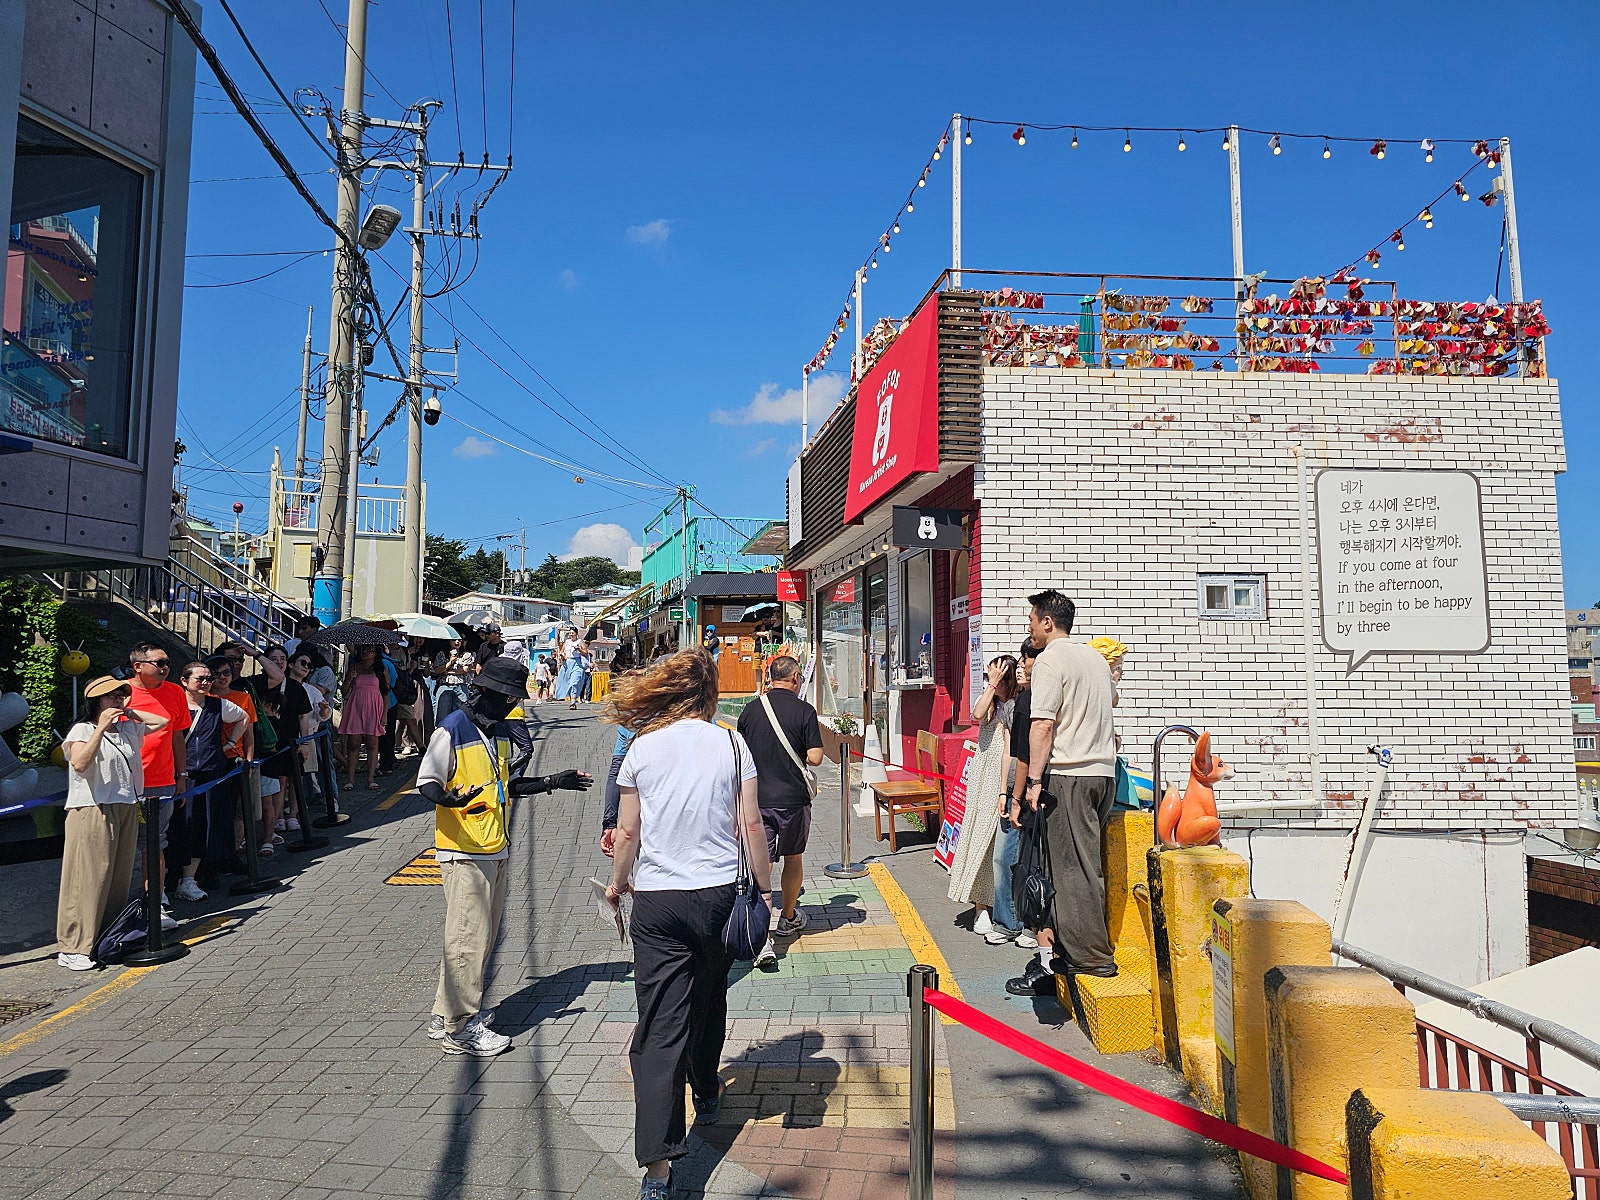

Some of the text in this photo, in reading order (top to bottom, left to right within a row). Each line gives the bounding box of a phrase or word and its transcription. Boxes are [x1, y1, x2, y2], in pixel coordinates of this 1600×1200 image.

[885, 454, 898, 471] Shop
[1341, 480, 1363, 495] 네가
[1340, 496, 1439, 514] 오후 4시에 온다면,
[1340, 516, 1436, 534] 나는 오후 3시부터
[1339, 534, 1461, 555] 행복해지기 시작할꺼야.
[1338, 556, 1458, 575] If you come at four
[1338, 579, 1442, 593] in the afternoon,
[1338, 597, 1472, 614] I'll begin to be happy
[1337, 621, 1390, 636] by three
[1218, 925, 1230, 952] 위험
